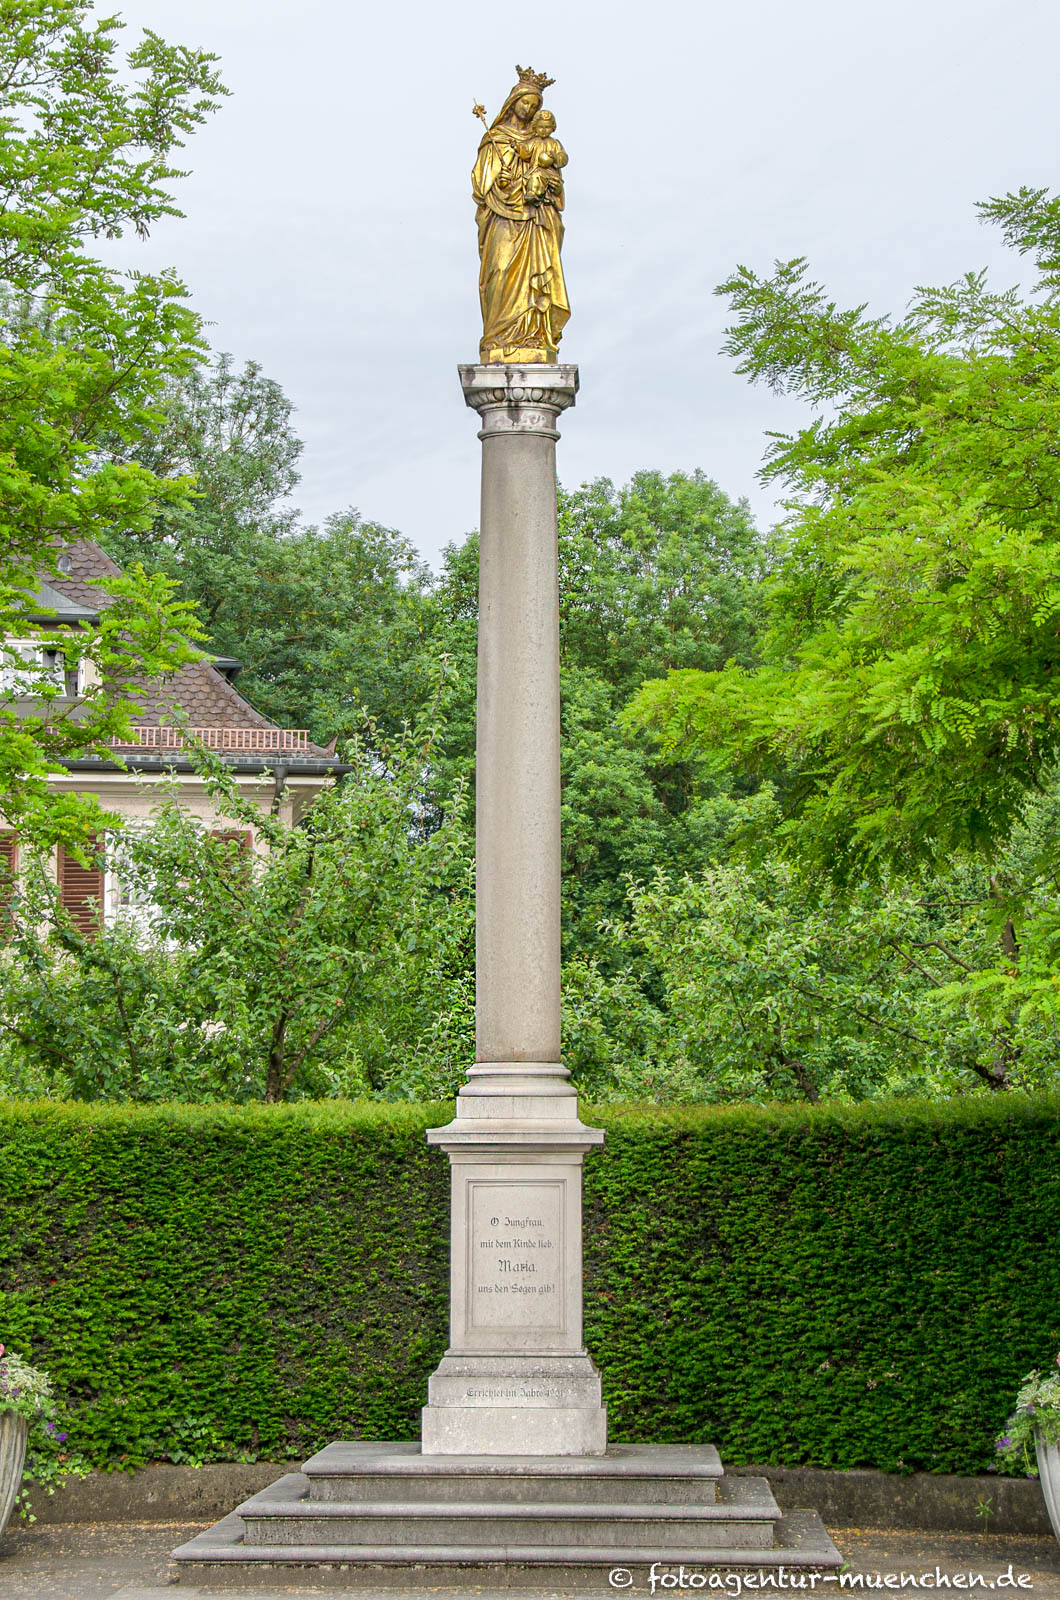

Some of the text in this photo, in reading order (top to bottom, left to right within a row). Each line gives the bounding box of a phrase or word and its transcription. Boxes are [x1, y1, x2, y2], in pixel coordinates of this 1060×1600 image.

[490, 1217, 499, 1226] O
[480, 1239, 494, 1249] mit
[495, 1239, 512, 1249] dem
[513, 1239, 537, 1249] Kinde
[494, 1284, 509, 1293] den
[511, 1283, 537, 1295] Segen
[538, 1284, 556, 1295] gib!
[519, 1387, 543, 1398] Jahre
